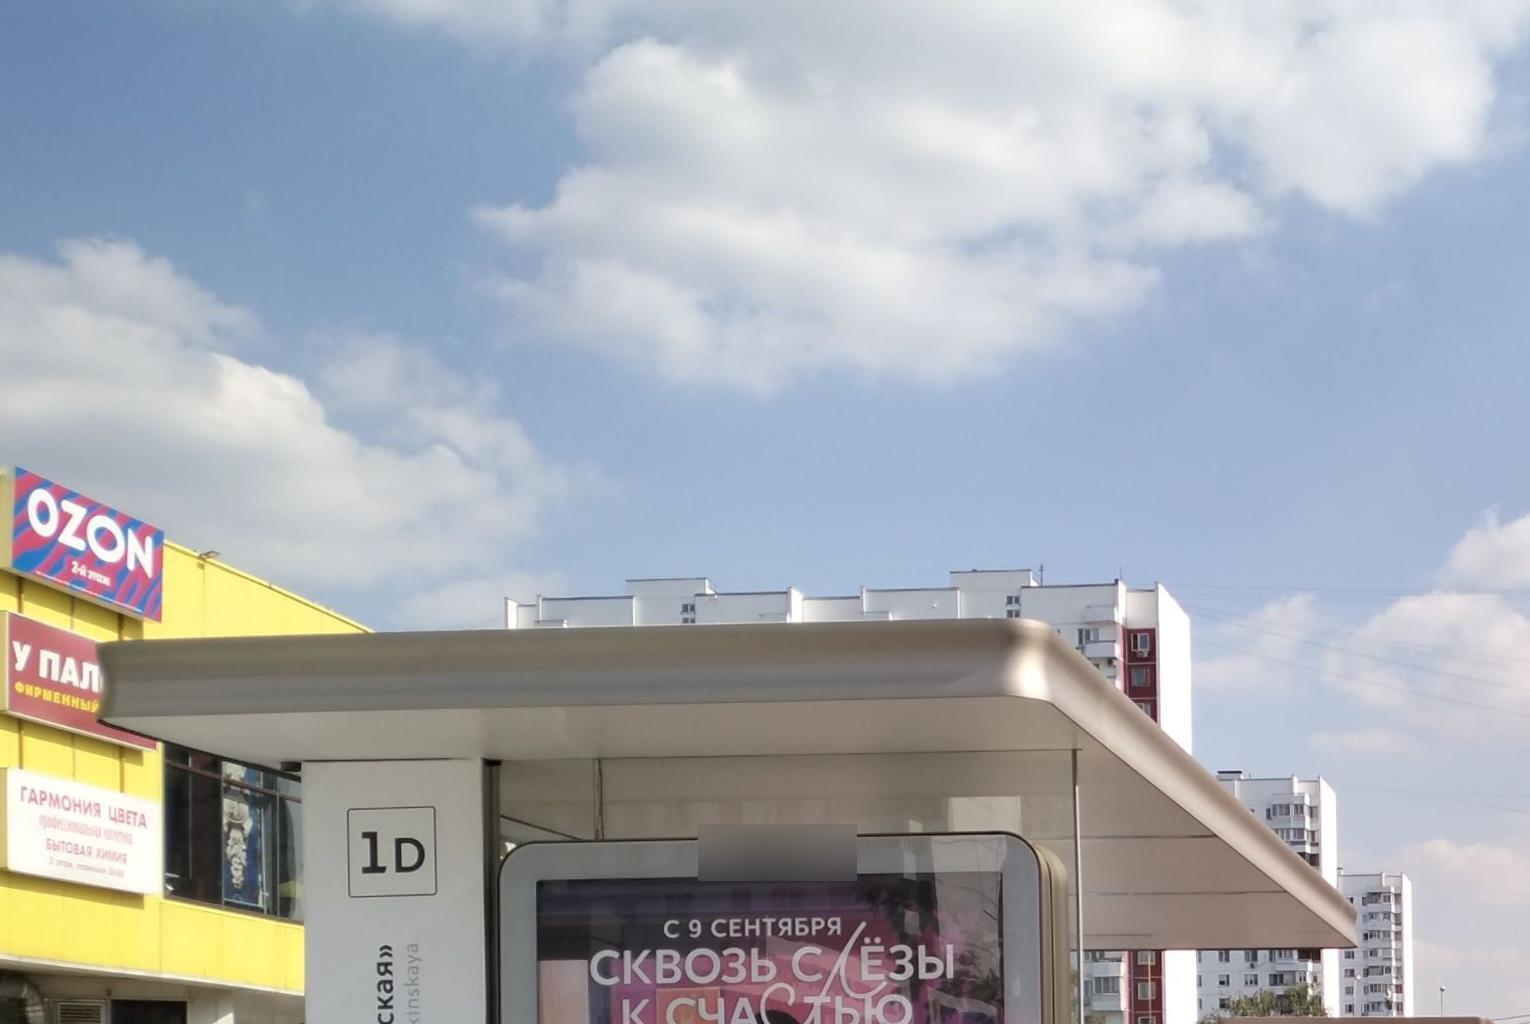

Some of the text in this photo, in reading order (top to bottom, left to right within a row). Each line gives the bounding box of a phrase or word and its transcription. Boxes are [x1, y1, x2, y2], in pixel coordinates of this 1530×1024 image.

[27, 488, 154, 579] OZON
[12, 640, 32, 672] У
[20, 786, 148, 829] ГАРМОНИЯ ЦВЕТА
[46, 838, 127, 864] БЫТОВАЯ ХИМИЯ
[360, 830, 426, 874] 1D
[663, 916, 842, 938] С 9 СЕНТЯБРЯ
[589, 921, 955, 1000] СКВОЗЬ СЛЁЗЫ
